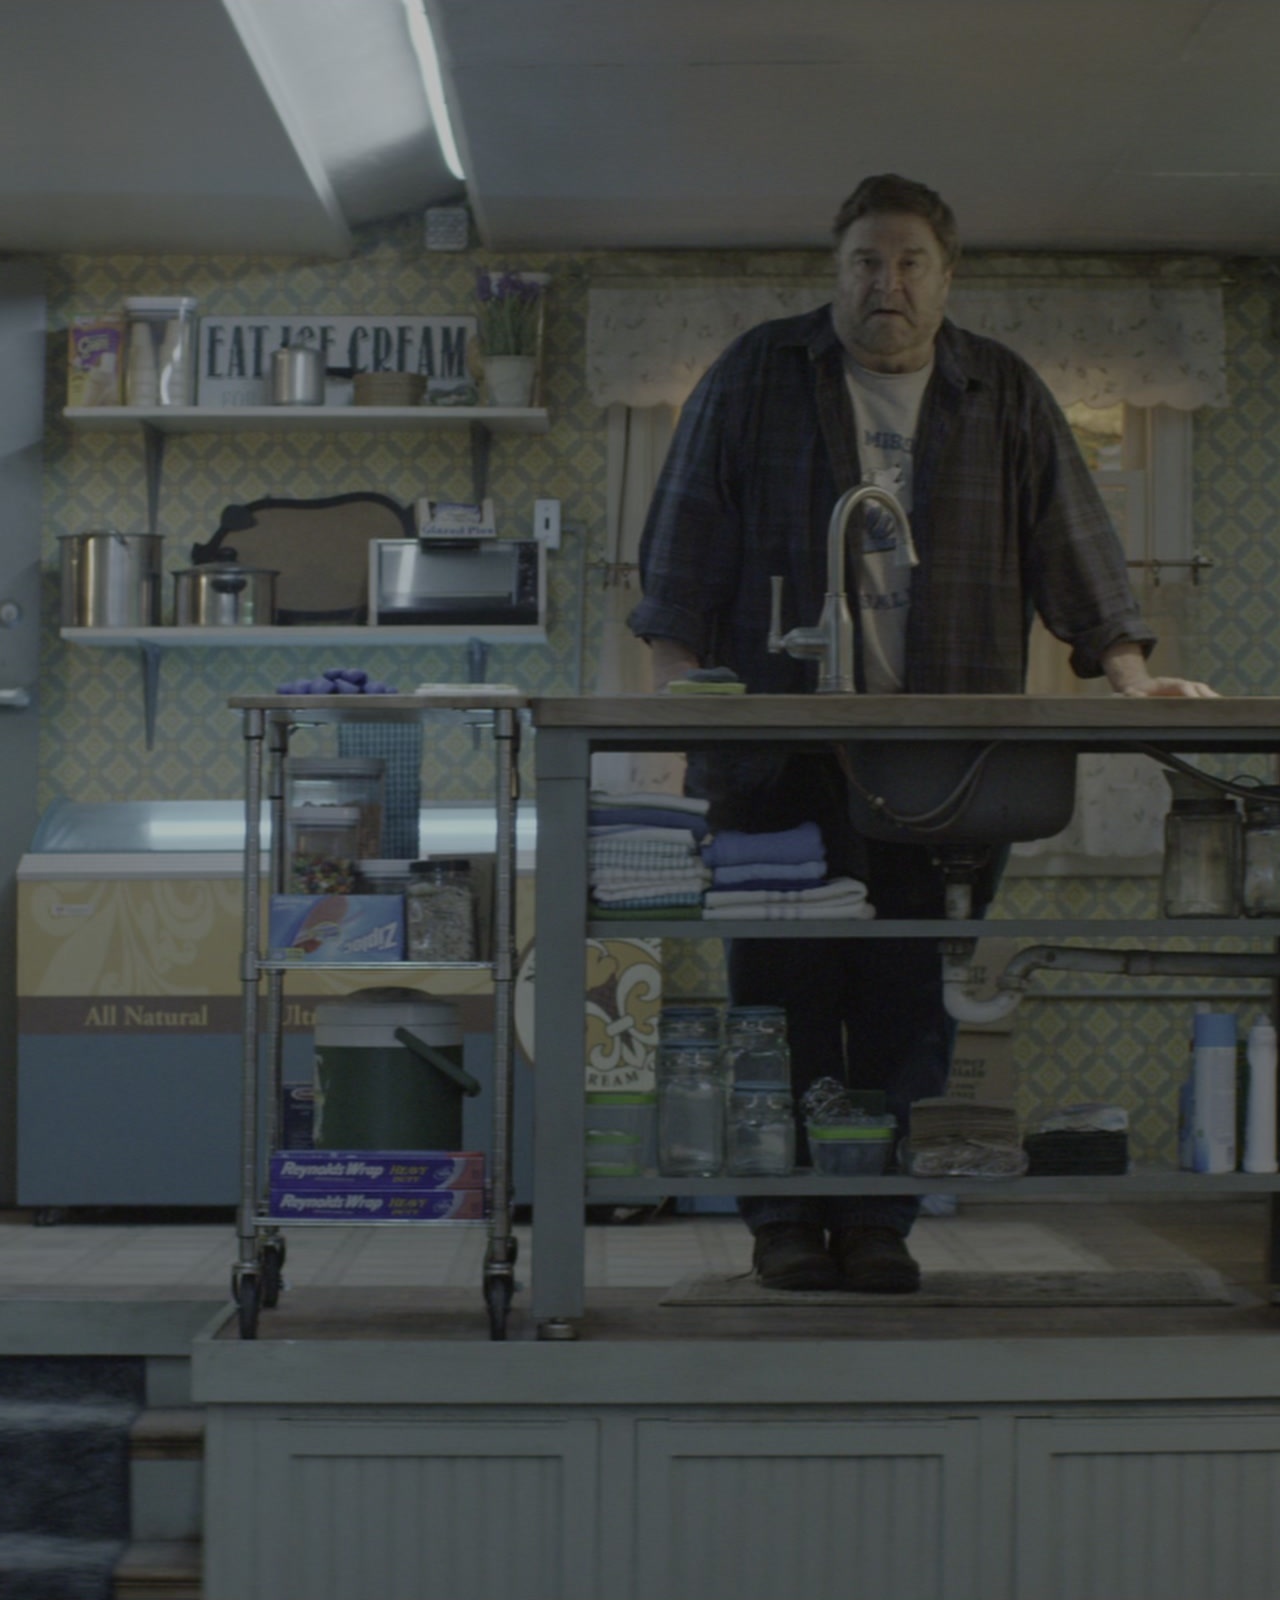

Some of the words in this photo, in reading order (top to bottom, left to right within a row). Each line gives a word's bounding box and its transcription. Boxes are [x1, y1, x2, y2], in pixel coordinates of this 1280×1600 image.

[207, 325, 269, 378] EAT
[348, 325, 467, 378] CREAM
[85, 1005, 117, 1026] All
[123, 1004, 209, 1027] Natural
[280, 1162, 345, 1179] Reynolds
[345, 1162, 385, 1179] Wrap
[279, 1193, 345, 1211] Reynolds
[344, 1194, 384, 1212] Wrap
